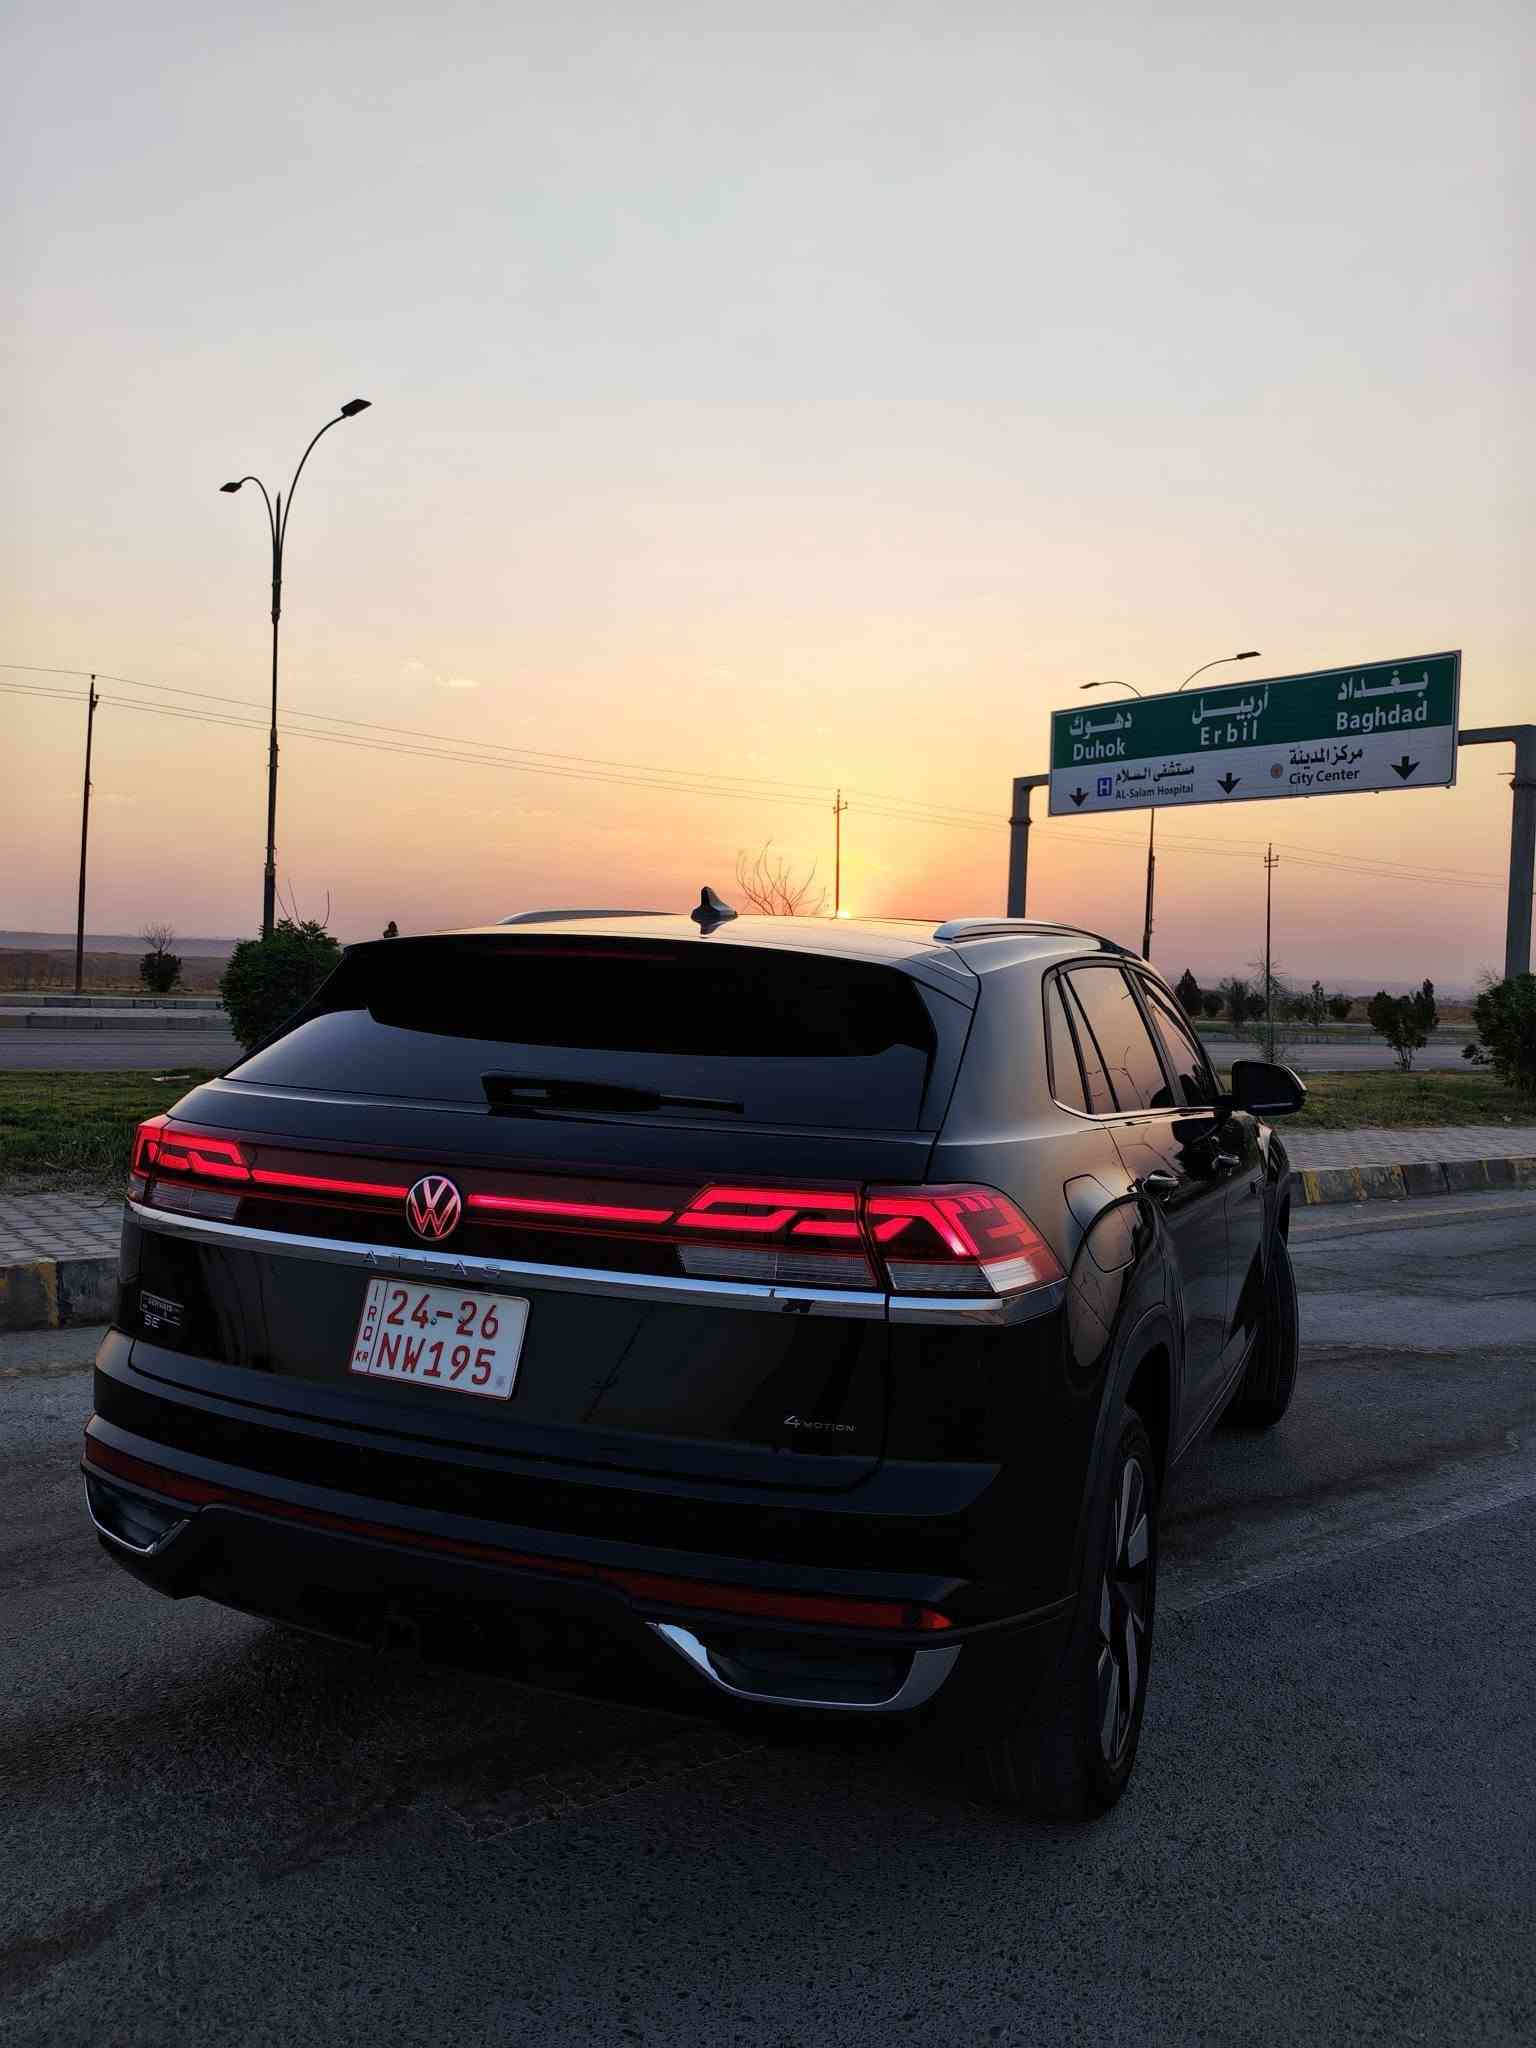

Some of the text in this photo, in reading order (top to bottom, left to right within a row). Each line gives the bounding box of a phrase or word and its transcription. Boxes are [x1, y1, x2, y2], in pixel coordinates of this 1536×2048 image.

[1337, 669, 1429, 701] بغداد
[1069, 712, 1133, 739] دهوك
[1336, 700, 1428, 732] Baghdad
[1200, 720, 1258, 746] Erbil
[1072, 737, 1126, 760] Duhok
[1331, 744, 1364, 766] مركز
[1157, 783, 1194, 797] Hospital
[1289, 769, 1360, 786] City Center
[386, 1289, 500, 1341] 24-26
[355, 1350, 369, 1363] KR
[375, 1331, 496, 1386] NW195
